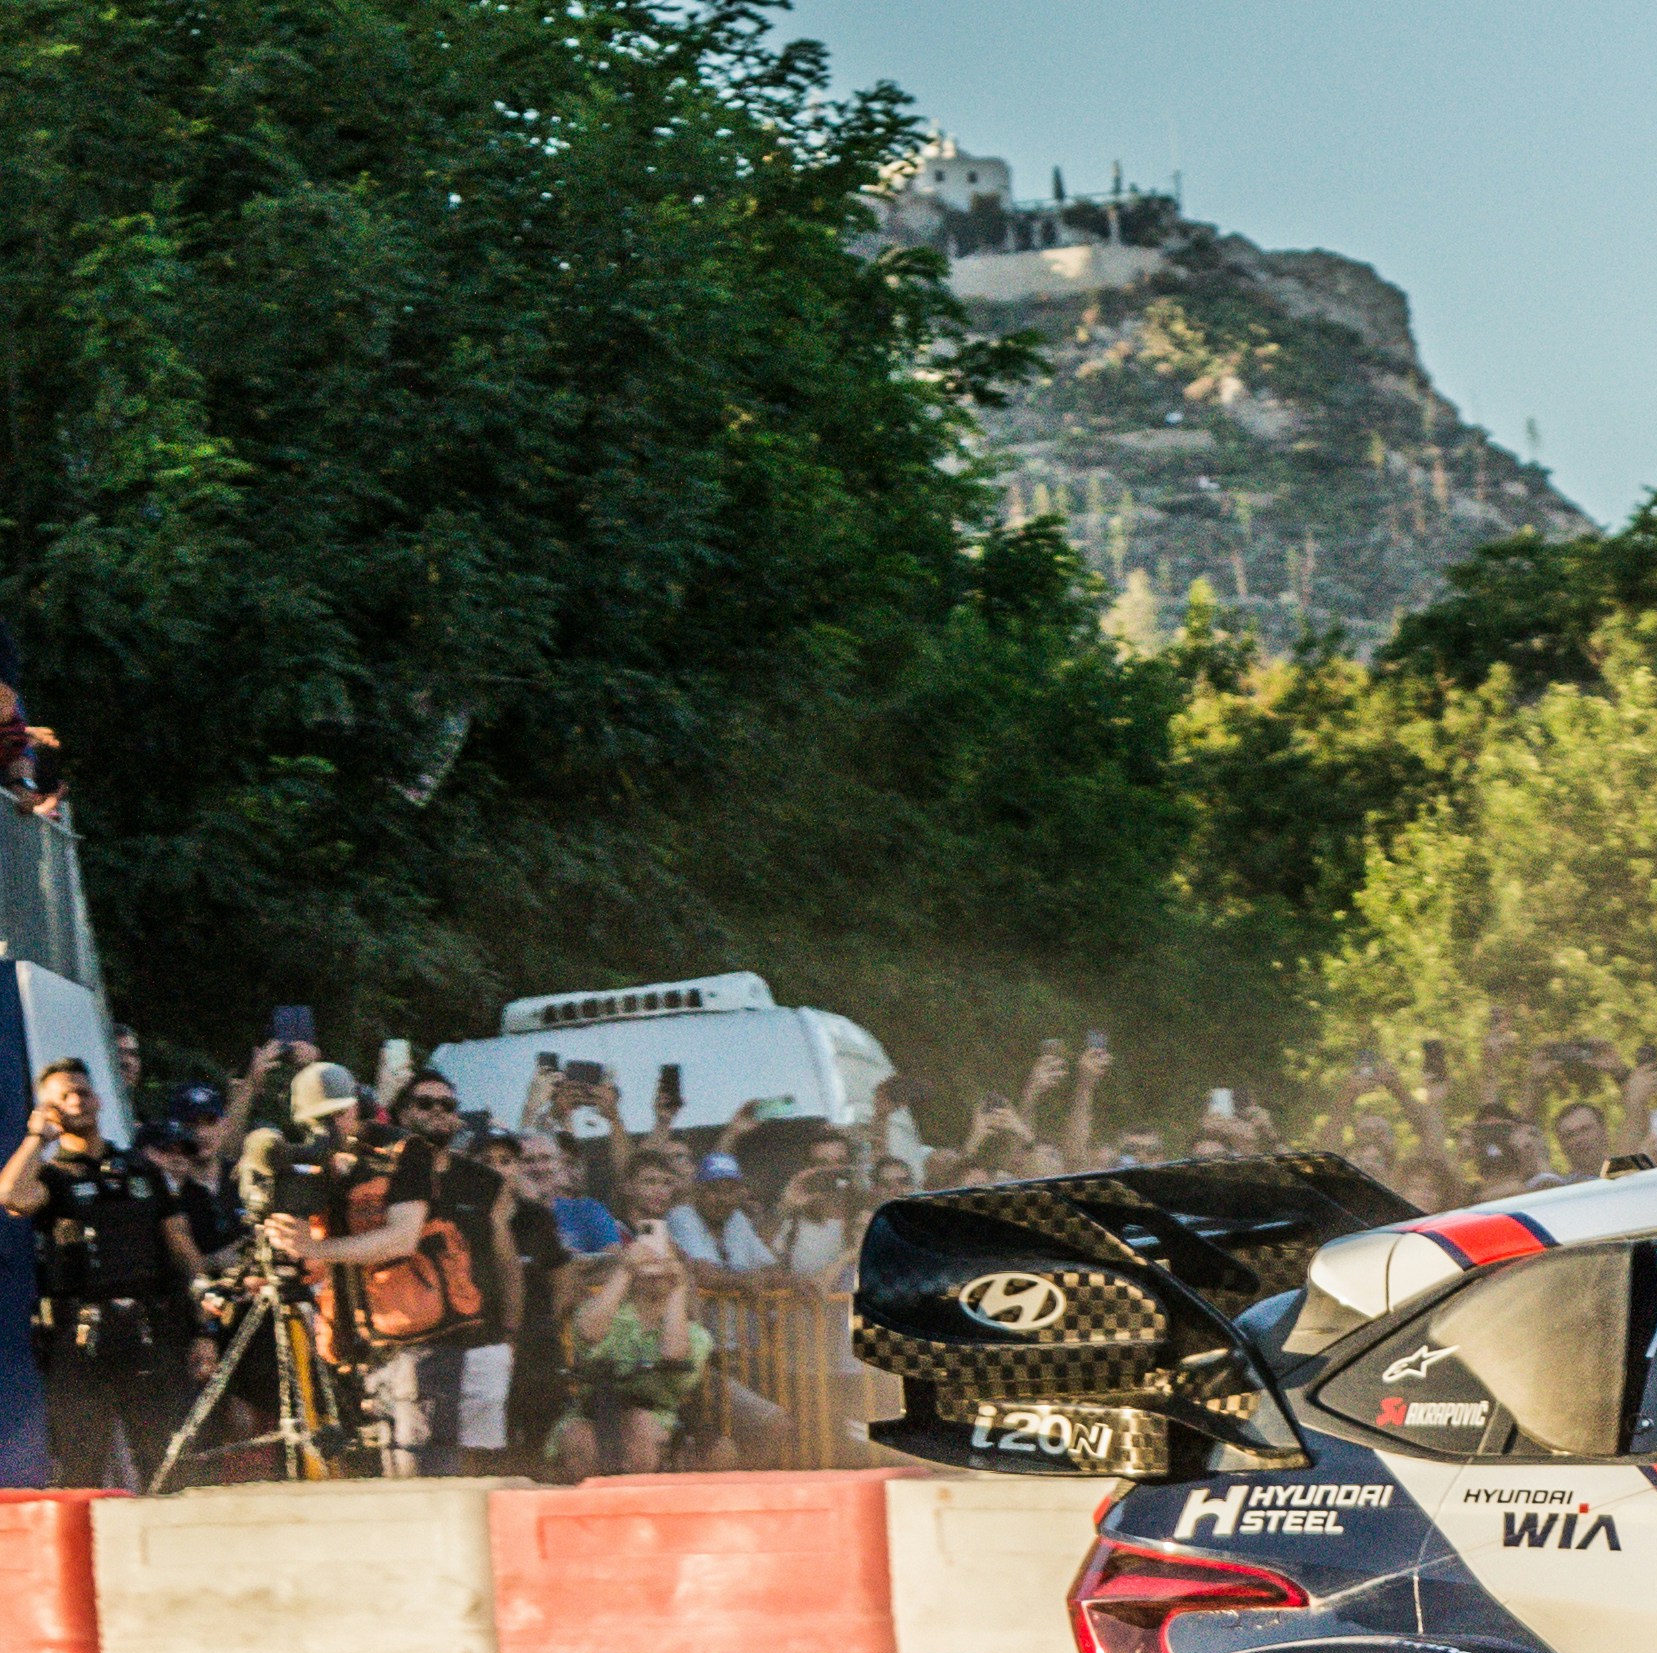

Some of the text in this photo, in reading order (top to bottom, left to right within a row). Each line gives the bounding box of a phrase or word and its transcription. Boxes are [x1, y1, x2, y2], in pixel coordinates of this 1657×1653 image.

[1249, 1484, 1395, 1508] HYUNDAI
[1463, 1488, 1574, 1505] HYUNDAI
[1238, 1510, 1345, 1535] STEEL
